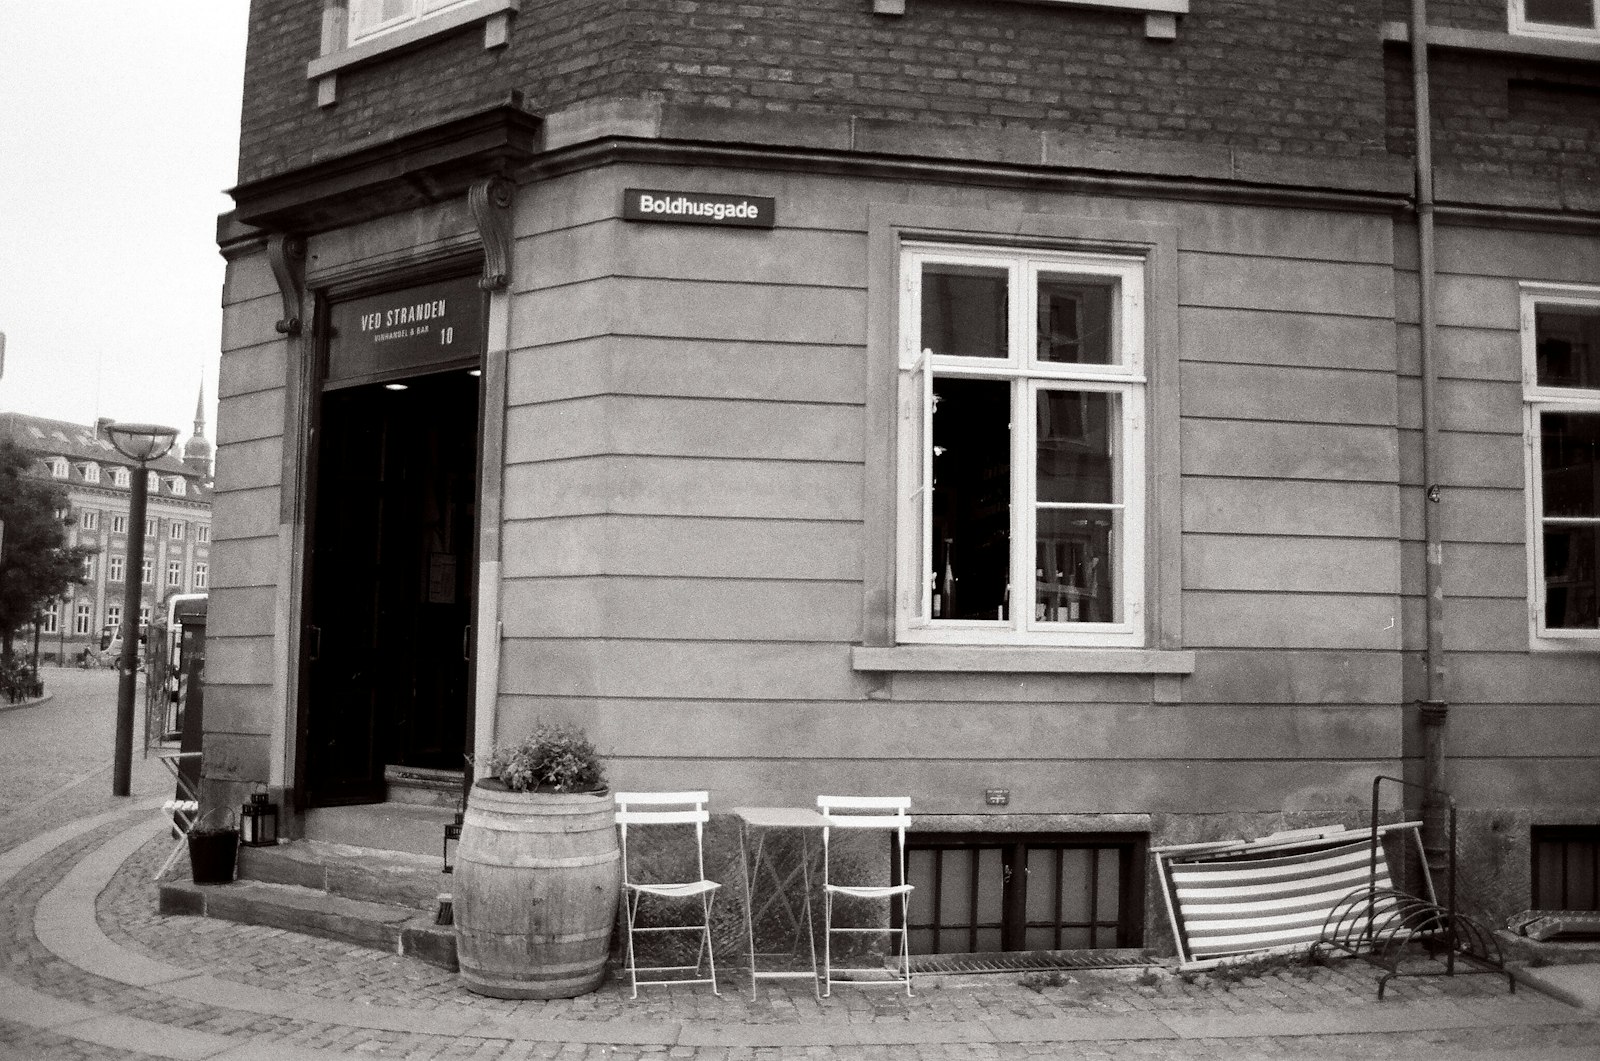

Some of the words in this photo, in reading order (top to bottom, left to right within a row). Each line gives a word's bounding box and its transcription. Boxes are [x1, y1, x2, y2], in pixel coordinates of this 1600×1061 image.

[640, 194, 758, 220] Boldhusgade
[361, 312, 381, 331] VED
[386, 300, 446, 326] STRANDEN
[416, 325, 429, 335] BAR
[441, 327, 453, 345] 10
